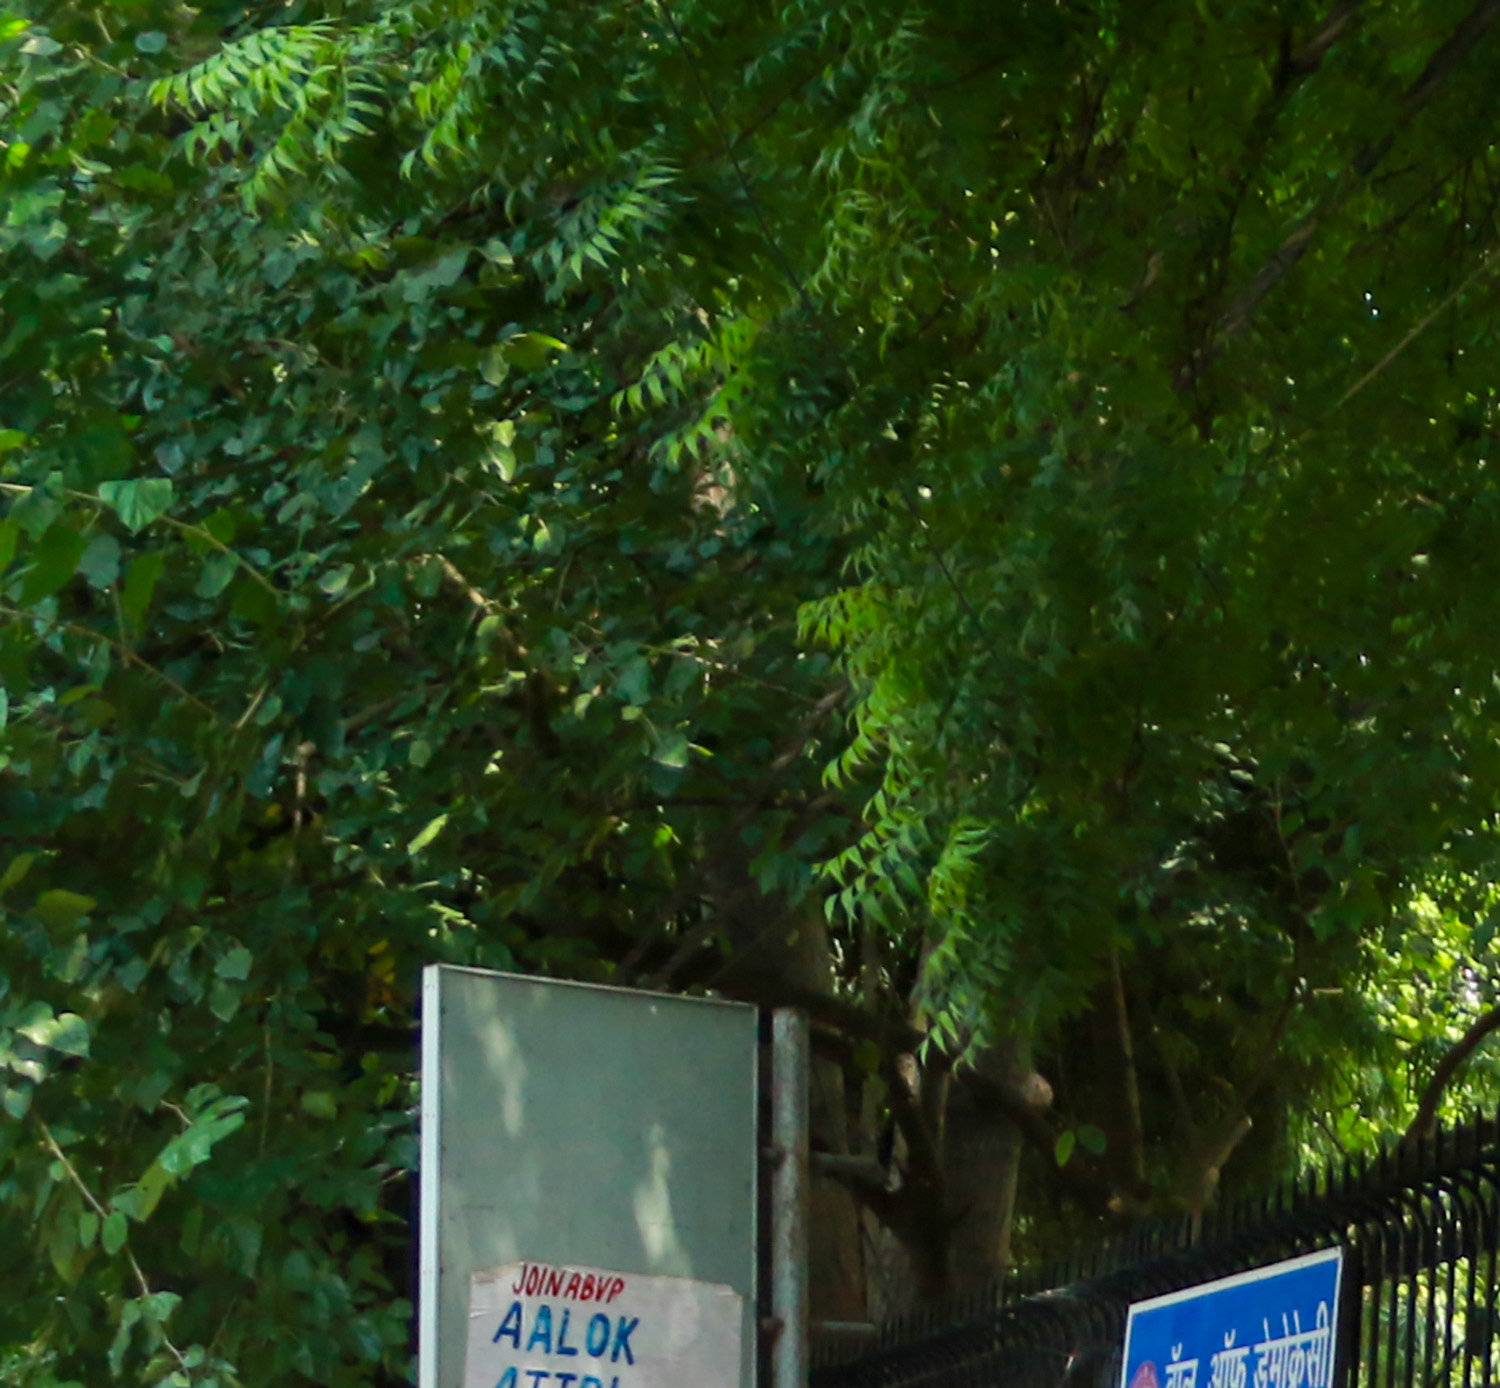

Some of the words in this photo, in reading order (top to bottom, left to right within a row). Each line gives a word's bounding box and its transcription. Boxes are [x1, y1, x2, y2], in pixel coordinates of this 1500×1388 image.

[512, 1265, 560, 1296] JOIN
[568, 1267, 624, 1303] ABVP
[493, 1302, 639, 1365] AALOK
